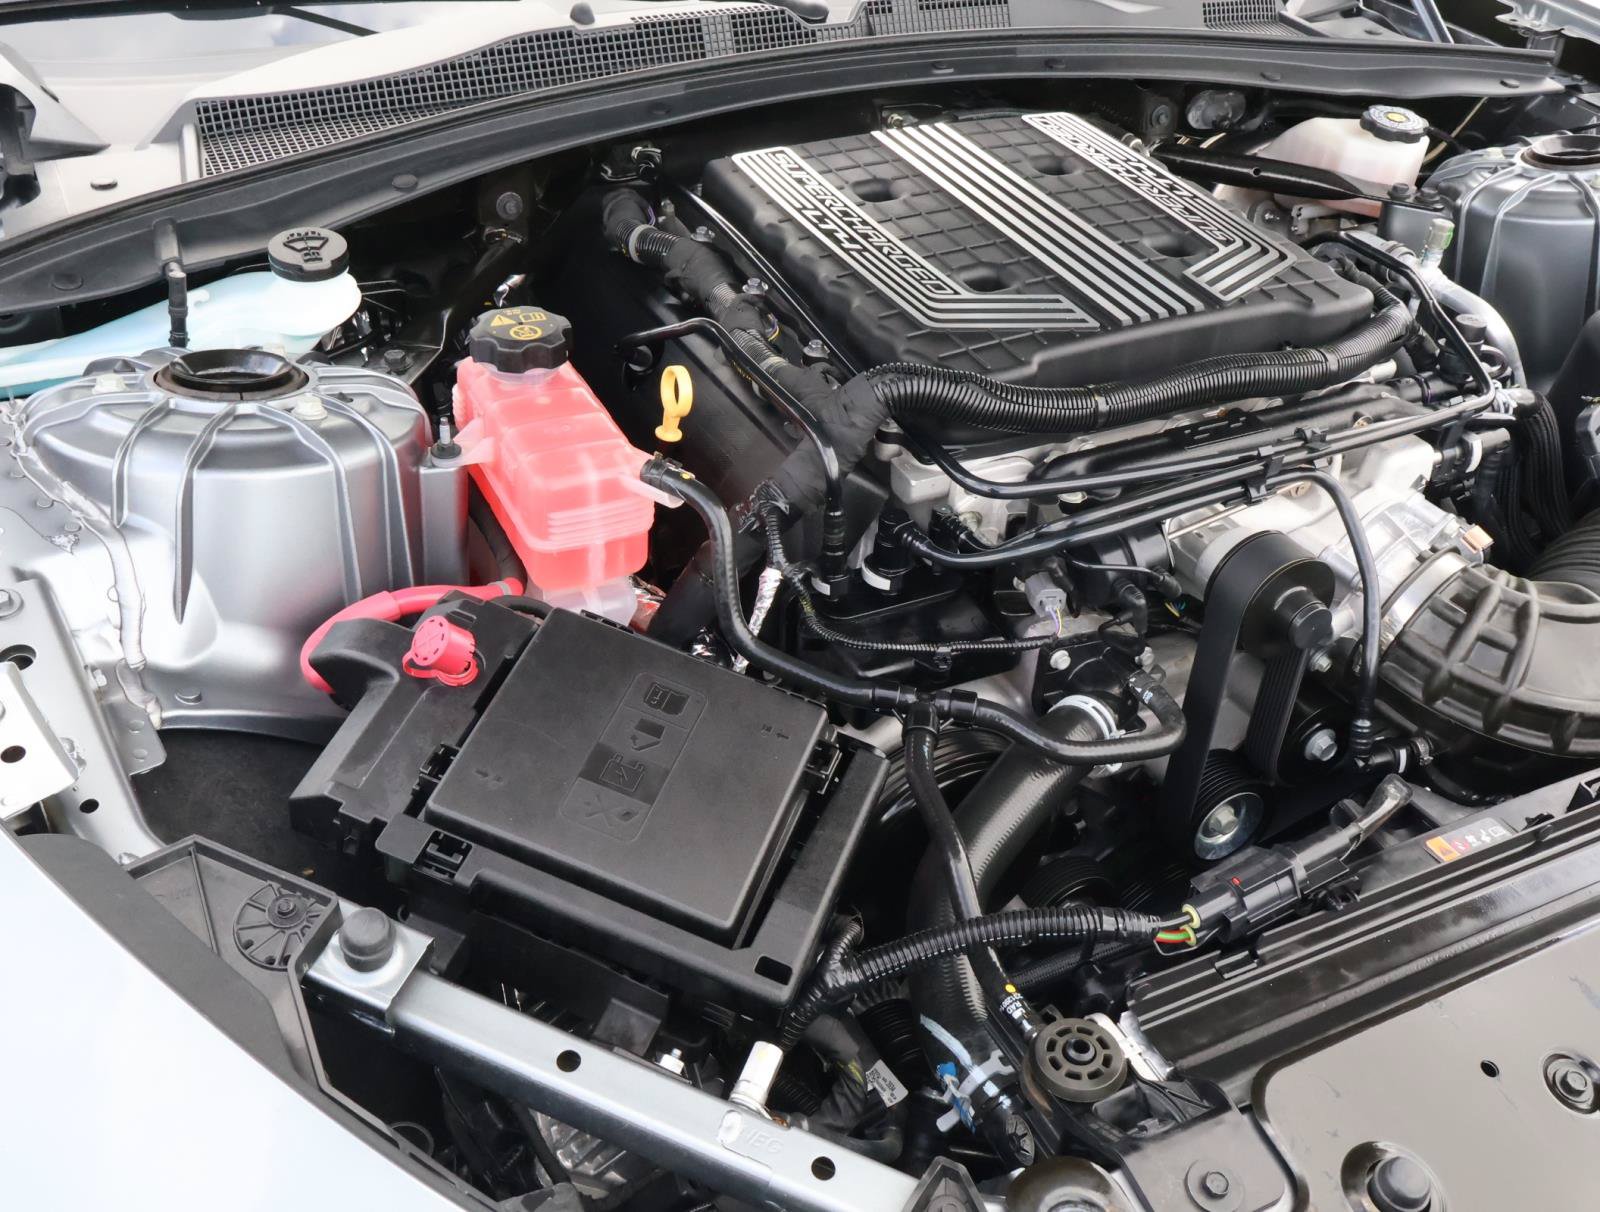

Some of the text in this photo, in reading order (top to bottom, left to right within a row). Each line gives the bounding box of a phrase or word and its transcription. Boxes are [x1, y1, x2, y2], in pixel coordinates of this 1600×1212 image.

[1036, 117, 1234, 242] SUPERCHARGED
[1128, 158, 1194, 199] LT4
[768, 152, 955, 295] SUPERCHARGED
[801, 207, 863, 252] LT4
